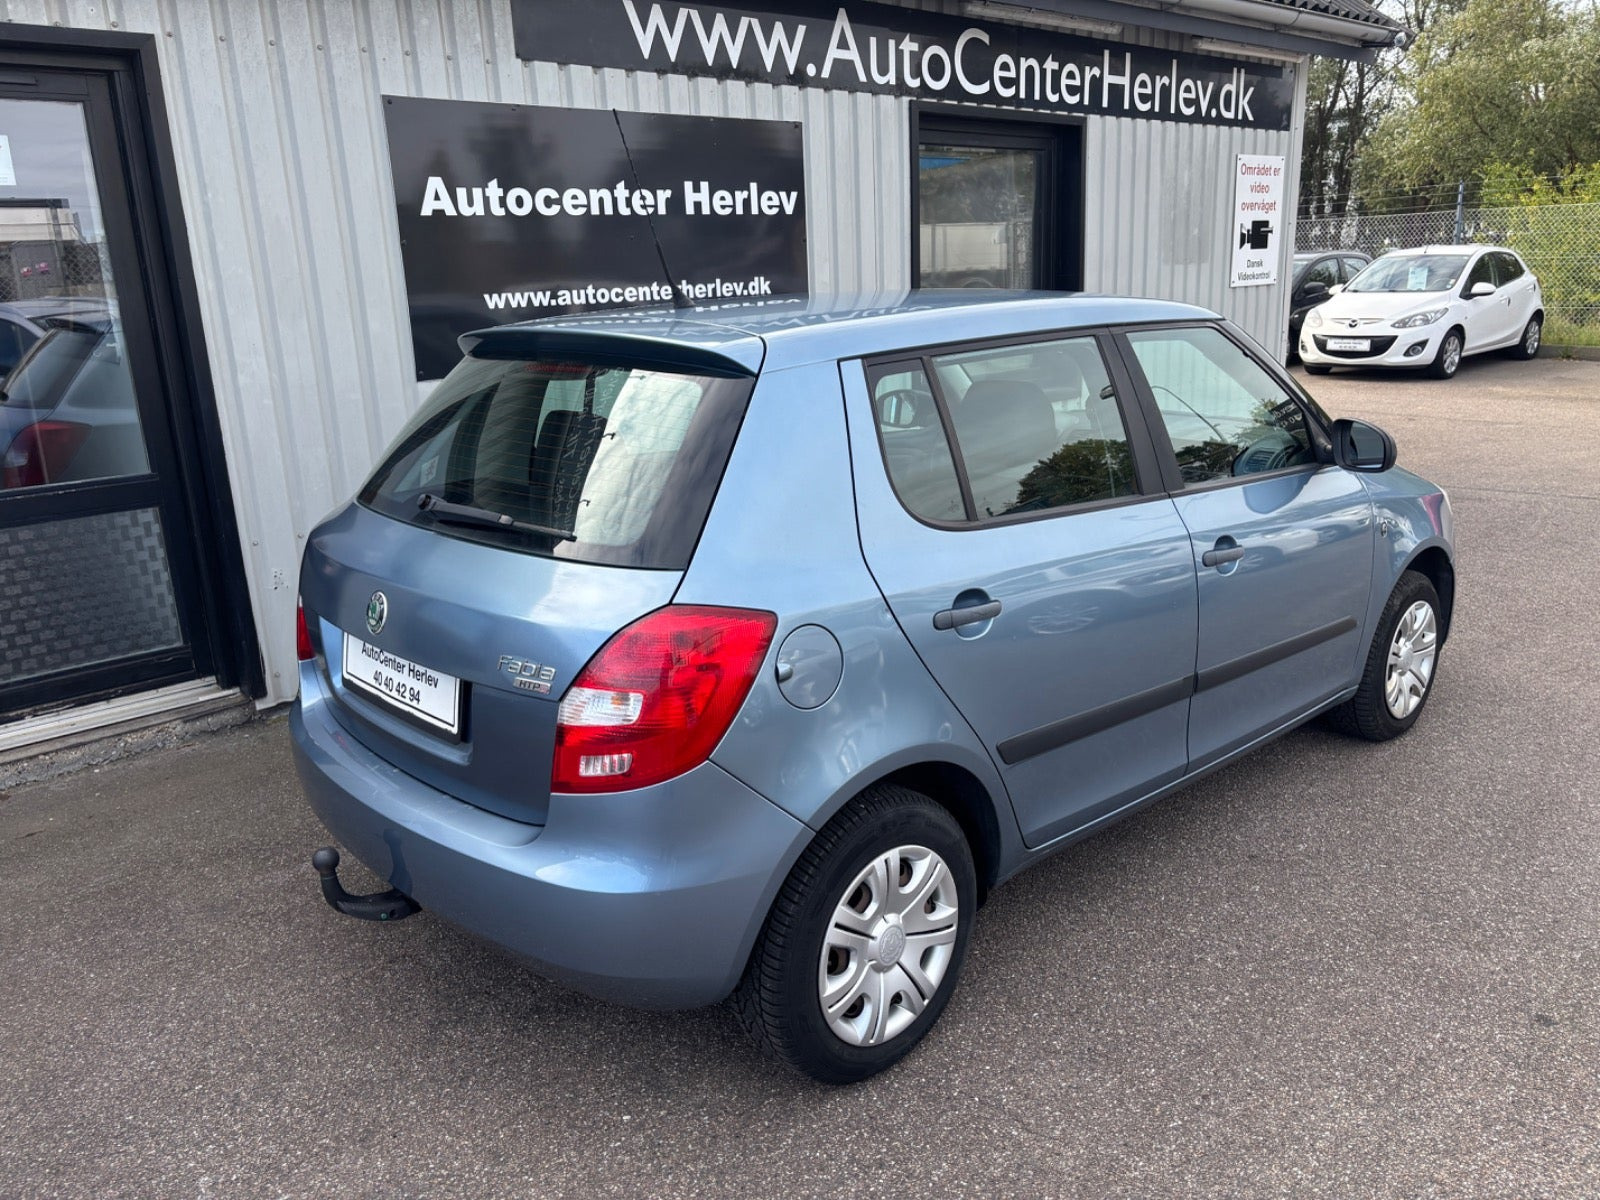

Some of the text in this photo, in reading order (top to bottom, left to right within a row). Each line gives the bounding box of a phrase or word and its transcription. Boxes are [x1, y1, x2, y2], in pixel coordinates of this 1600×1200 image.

[622, 0, 1255, 122] www.AutoCenterHerlev.dk
[1240, 162, 1281, 177] Området er
[420, 176, 798, 217] Autocenter Herlev
[1250, 181, 1270, 194] video
[1240, 199, 1276, 213] overvåget
[1237, 270, 1271, 281] Videokontrol
[1246, 259, 1263, 269] Dansk
[483, 275, 772, 310] www.autocenteherlev.dk
[361, 641, 439, 689] AutoCenter Herlev
[372, 669, 421, 705] 40 40 42 94
